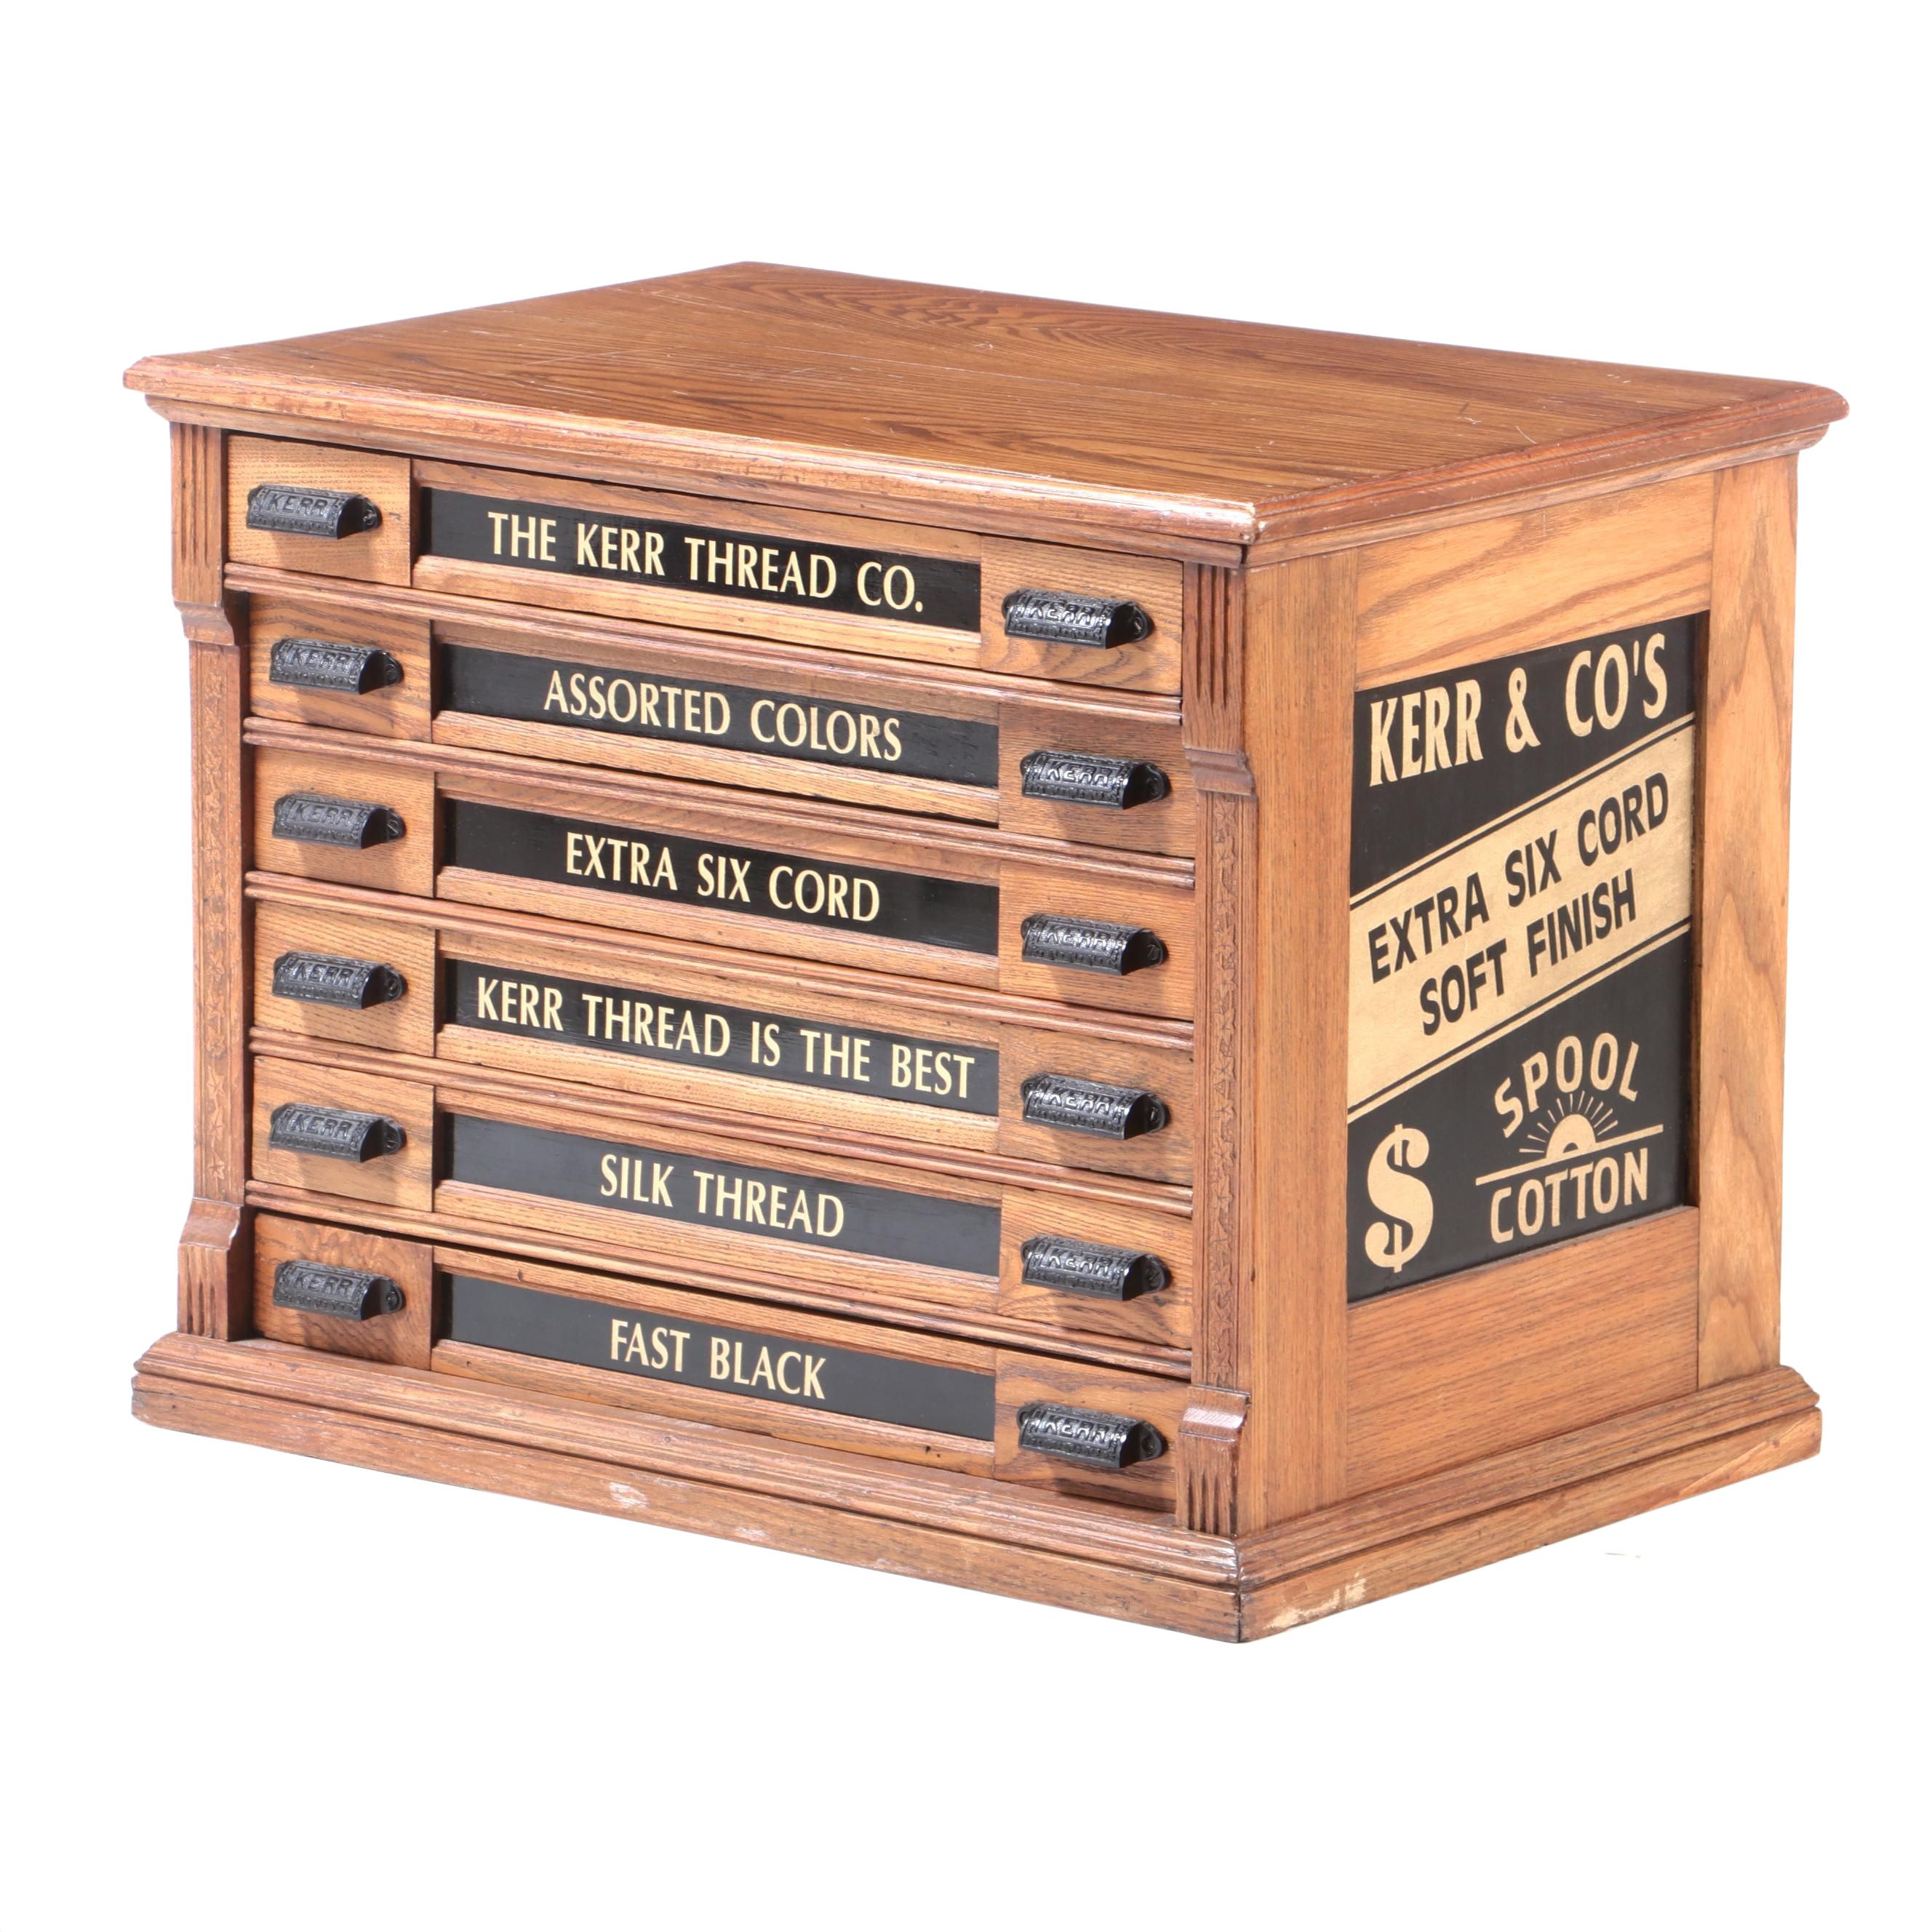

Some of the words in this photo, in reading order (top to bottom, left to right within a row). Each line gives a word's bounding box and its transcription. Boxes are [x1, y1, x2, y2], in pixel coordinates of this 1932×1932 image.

[266, 492, 330, 515] KERR
[488, 511, 556, 562] THE
[578, 523, 665, 575] KERR
[684, 538, 836, 598] THREAD
[858, 562, 922, 612] CO.
[292, 647, 352, 670] KERR
[544, 671, 730, 735] ASSORTED
[751, 700, 901, 761] COLORS
[1370, 679, 1483, 786] KERR
[1506, 668, 1541, 753] &
[1565, 633, 1667, 736] CO'S
[294, 802, 353, 825] KERR
[567, 832, 677, 890] EXTRA
[698, 854, 751, 902] SIX
[770, 866, 879, 921] CORD
[1369, 873, 1489, 983] EXTRA
[1506, 830, 1561, 906] SIX
[1578, 773, 1667, 866] CORD
[297, 962, 354, 985] KERR
[1421, 939, 1506, 1035] SOFT
[1528, 869, 1635, 976] FINISH
[478, 977, 564, 1031] KERR
[582, 994, 730, 1057] THREAD
[751, 1021, 781, 1066] IS
[800, 1029, 870, 1082] THE
[891, 1044, 975, 1098] BEST
[293, 1118, 353, 1138] KERR
[1495, 1033, 1639, 1138] SPOOL
[600, 1154, 674, 1208] SILK
[693, 1170, 844, 1237] THREAD
[1365, 1124, 1433, 1273] $
[1490, 1148, 1648, 1243] COTTON
[295, 1274, 354, 1295] KERR
[611, 1319, 690, 1372] FAST
[710, 1337, 826, 1400] BLACK
